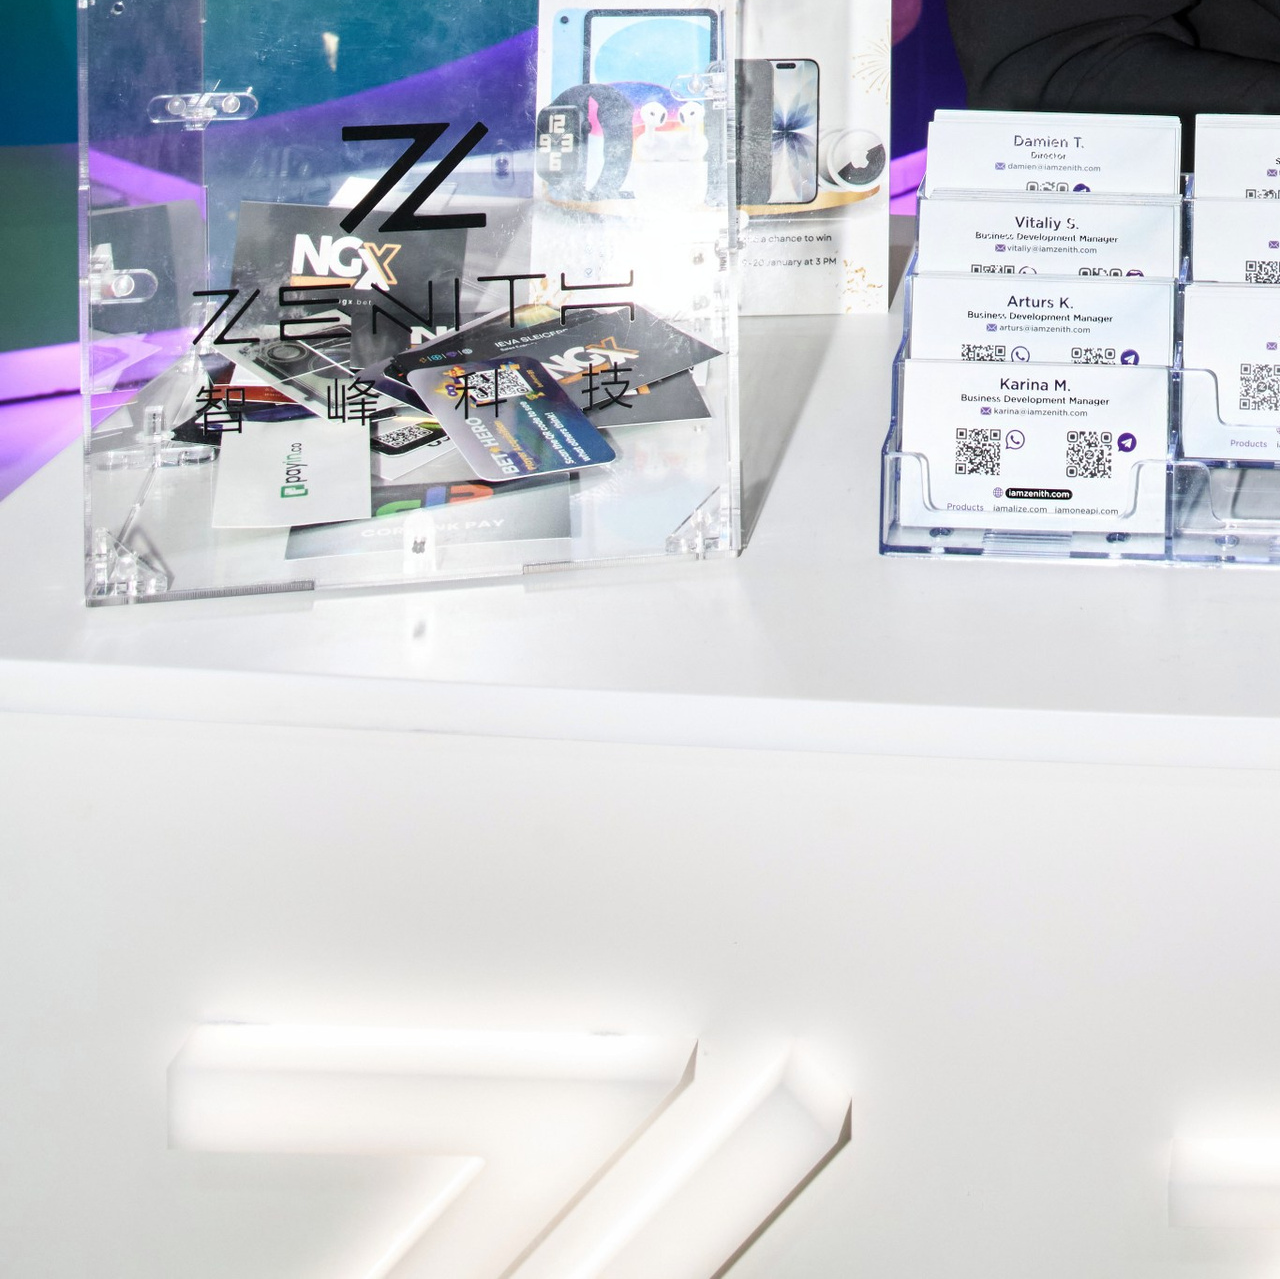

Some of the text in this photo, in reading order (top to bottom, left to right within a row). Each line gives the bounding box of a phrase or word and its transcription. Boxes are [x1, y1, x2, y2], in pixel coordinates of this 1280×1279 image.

[1014, 135, 1085, 149] Damien T.
[1031, 151, 1066, 160] Director
[1007, 162, 1101, 173] damien@iamzenith.com
[1015, 216, 1079, 231] Vitaliy S.
[768, 233, 802, 242] chance
[804, 234, 813, 242] to
[815, 233, 832, 242] win
[975, 231, 1119, 245] Business Development Manager
[1007, 244, 1098, 255] vitaliy@iamzenith.com
[291, 233, 402, 292] NGX
[804, 258, 813, 266] at
[815, 258, 822, 266] 3
[823, 257, 837, 266] PM
[192, 269, 636, 346] ZENITH
[1007, 295, 1074, 309] Arturs K.
[967, 310, 1113, 325] Business Development Manager
[999, 324, 1091, 334] arturs@iamzenith.com
[494, 338, 519, 348] IEVA
[542, 335, 640, 380] NGX
[1000, 377, 1071, 392] Karina M.
[961, 393, 1110, 408] Business Development Manager
[993, 407, 1088, 418] karina@iamzenith.com
[1230, 439, 1268, 448] Products
[1008, 488, 1070, 499] iamzenith.com
[946, 502, 1119, 516] Products iamalize.com iamoneapi.com
[461, 518, 506, 531] PAY
